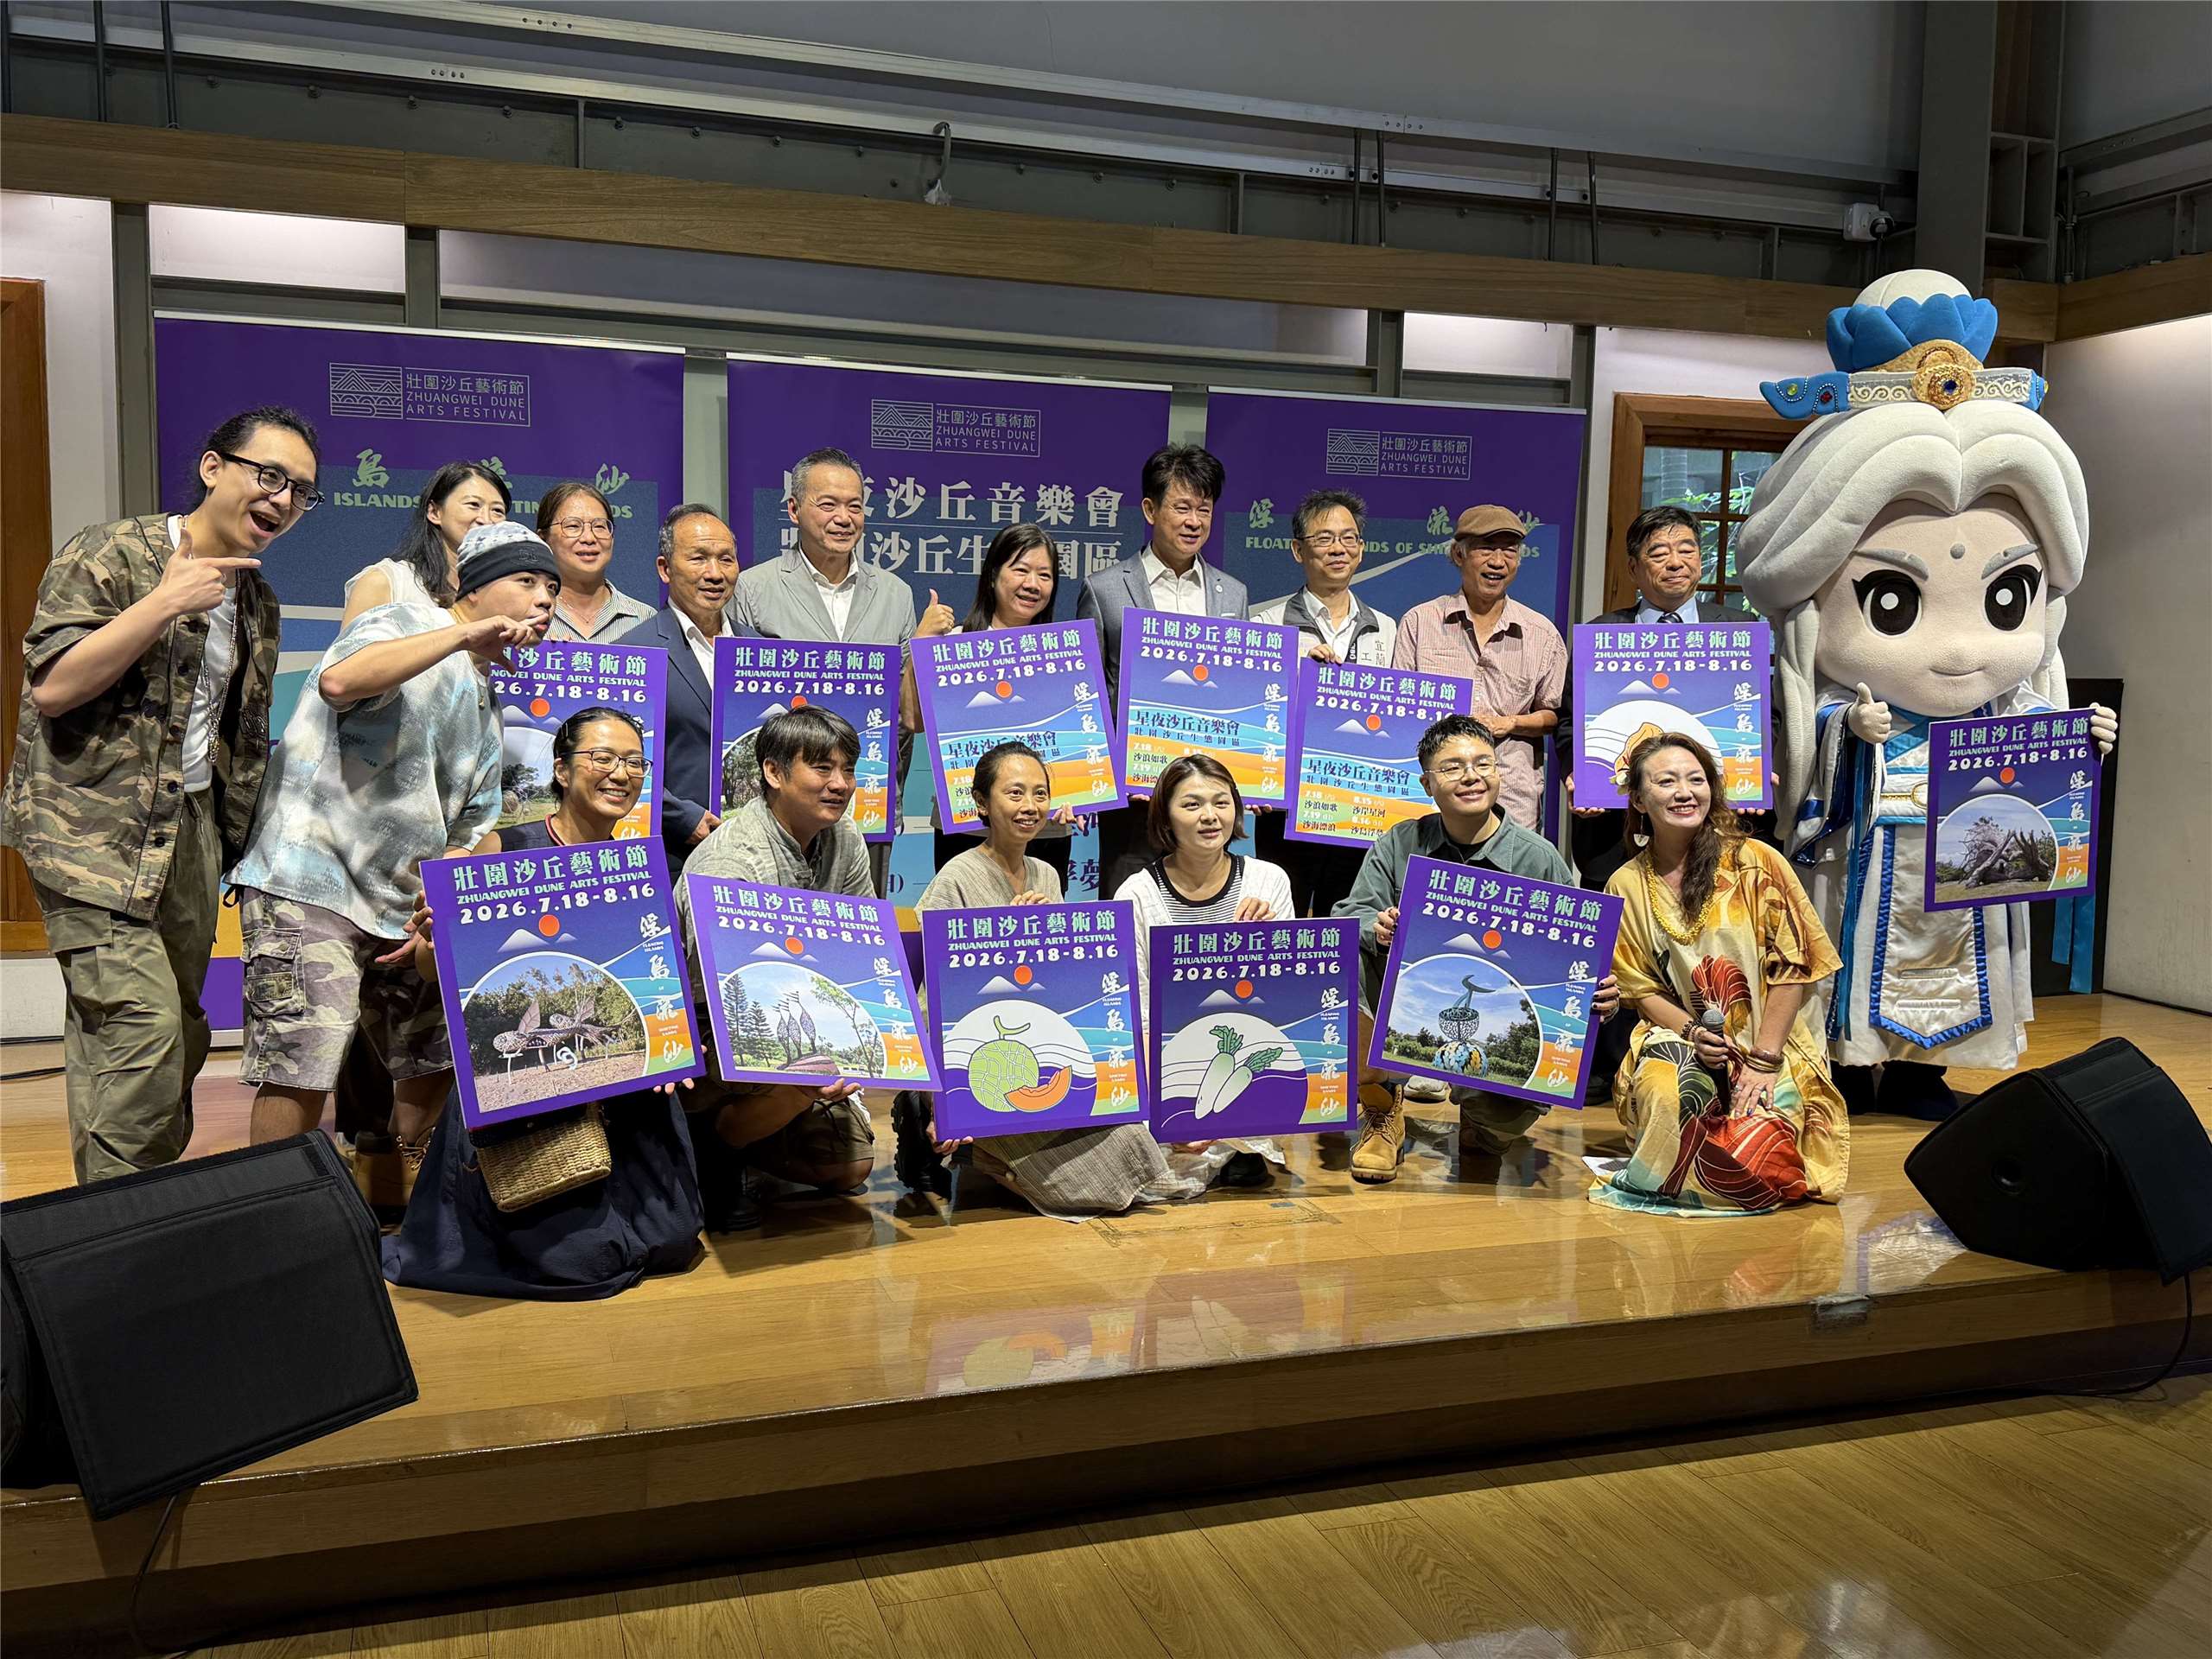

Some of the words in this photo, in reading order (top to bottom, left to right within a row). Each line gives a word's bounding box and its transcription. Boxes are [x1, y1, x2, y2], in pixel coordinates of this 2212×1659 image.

[406, 372, 524, 395] 壯圍沙丘藝術節
[406, 391, 485, 406] ZHUANGWEI
[491, 395, 525, 409] DUNE
[406, 404, 444, 416] ARTS
[454, 405, 525, 422] FESTIVAL
[936, 410, 1036, 429] 壯圍沙丘藝術節
[936, 426, 1001, 438] ZHUANGWEI
[1007, 429, 1036, 441] DUNE
[936, 437, 968, 449] ARTS
[976, 439, 1036, 453] FESTIVAL
[1382, 436, 1467, 454] 壯圍沙丘藝術節
[1381, 463, 1408, 474] ARTS
[1414, 464, 1467, 476] FESTIVAL
[1382, 452, 1437, 463] ZHUANGWEI
[1442, 454, 1467, 464] DUNE
[780, 528, 1122, 580] 沙丘生園區
[1246, 537, 1292, 550] FLOAT
[1395, 543, 1413, 554] OF
[1142, 617, 1282, 650] 壯圍沙丘藝術節
[1594, 631, 1751, 650] 壯圍沙丘藝術節
[932, 630, 1080, 663] 壯圍沙丘藝術節
[1141, 636, 1192, 649] ZHUANGWEI
[1196, 643, 1218, 652] DUNE
[1221, 646, 1243, 655] ARTS
[1246, 649, 1282, 659] FESTIVAL
[1141, 645, 1282, 672] 2026.7.18-8.16
[503, 646, 647, 677] 沙丘藝術節
[735, 647, 886, 671] 壯圍沙丘藝術節
[935, 661, 989, 672] ZHUANGWEI
[993, 658, 1016, 666] DUNE
[1020, 654, 1042, 663] ARTS
[1045, 649, 1084, 659] FESTIVAL
[1593, 659, 1752, 672] 2026.7.18-8.16
[533, 672, 563, 681] DUNE
[567, 674, 594, 684] ARTS
[599, 677, 646, 687] FESTIVAL
[734, 670, 790, 678] ZHUANGWEI
[938, 659, 1086, 687] 2026.7.18-8.16
[1319, 667, 1457, 701] 壯圍沙丘藝術節
[494, 681, 646, 702] 26.7.18-8.16
[734, 680, 885, 696] 2026.7.18-8.16
[1317, 686, 1367, 699] ZHUANGWEI
[1395, 696, 1416, 705] ARTS
[1419, 699, 1455, 710] FESTIVAL
[1137, 711, 1240, 735] 星夜沙丘音樂會
[1950, 717, 2088, 747] 壯圍沙丘藝術節
[1949, 746, 1999, 757] ZHUANGWEI
[2003, 743, 2024, 752] DUNE
[2028, 741, 2049, 749] ARTS
[2052, 737, 2088, 747] FESTIVAL
[1948, 747, 2088, 772] 2026.7.18-8.16
[1308, 759, 1410, 785] 星夜沙丘音樂會
[453, 845, 648, 891] 壯圍沙丘藝術節
[456, 887, 530, 906] ZHUANGWEI
[534, 882, 565, 895] DUNE
[569, 877, 599, 889] ARTS
[603, 871, 652, 884] FESTIVAL
[1428, 869, 1603, 922] 壯圍沙丘藝術節
[461, 883, 655, 925] 2026.7.18-8.16
[713, 885, 879, 923] 壯圍沙丘藝術節
[1426, 891, 1487, 910] ZHUANGWEI
[1491, 904, 1518, 917] DUNE
[1522, 911, 1548, 923] ARTS
[1552, 917, 1598, 933] FESTIVAL
[715, 906, 778, 920] ZHUANGWEI
[781, 914, 808, 925] DUNE
[811, 918, 836, 928] ARTS
[840, 921, 882, 932] FESTIVAL
[718, 916, 886, 946] 2026.7.18-8.16
[947, 911, 1116, 940] 壯圍沙丘藝術節
[1422, 902, 1595, 948] 2026.7.18-8.16
[948, 940, 1010, 951] ZHUANGWEI
[1014, 938, 1040, 947] DUNE
[1045, 936, 1070, 945] ARTS
[1074, 933, 1117, 944] FESTIVAL
[1173, 927, 1340, 955] 壯圍沙丘藝術節
[949, 944, 1118, 969] 2026.7.18-8.16
[1173, 956, 1233, 965] ZHUANGWEI
[1237, 953, 1263, 963] DUNE
[1268, 952, 1293, 961] ARTS
[1297, 950, 1340, 959] FESTIVAL
[1173, 962, 1340, 982] 2026.7.18-8.16
